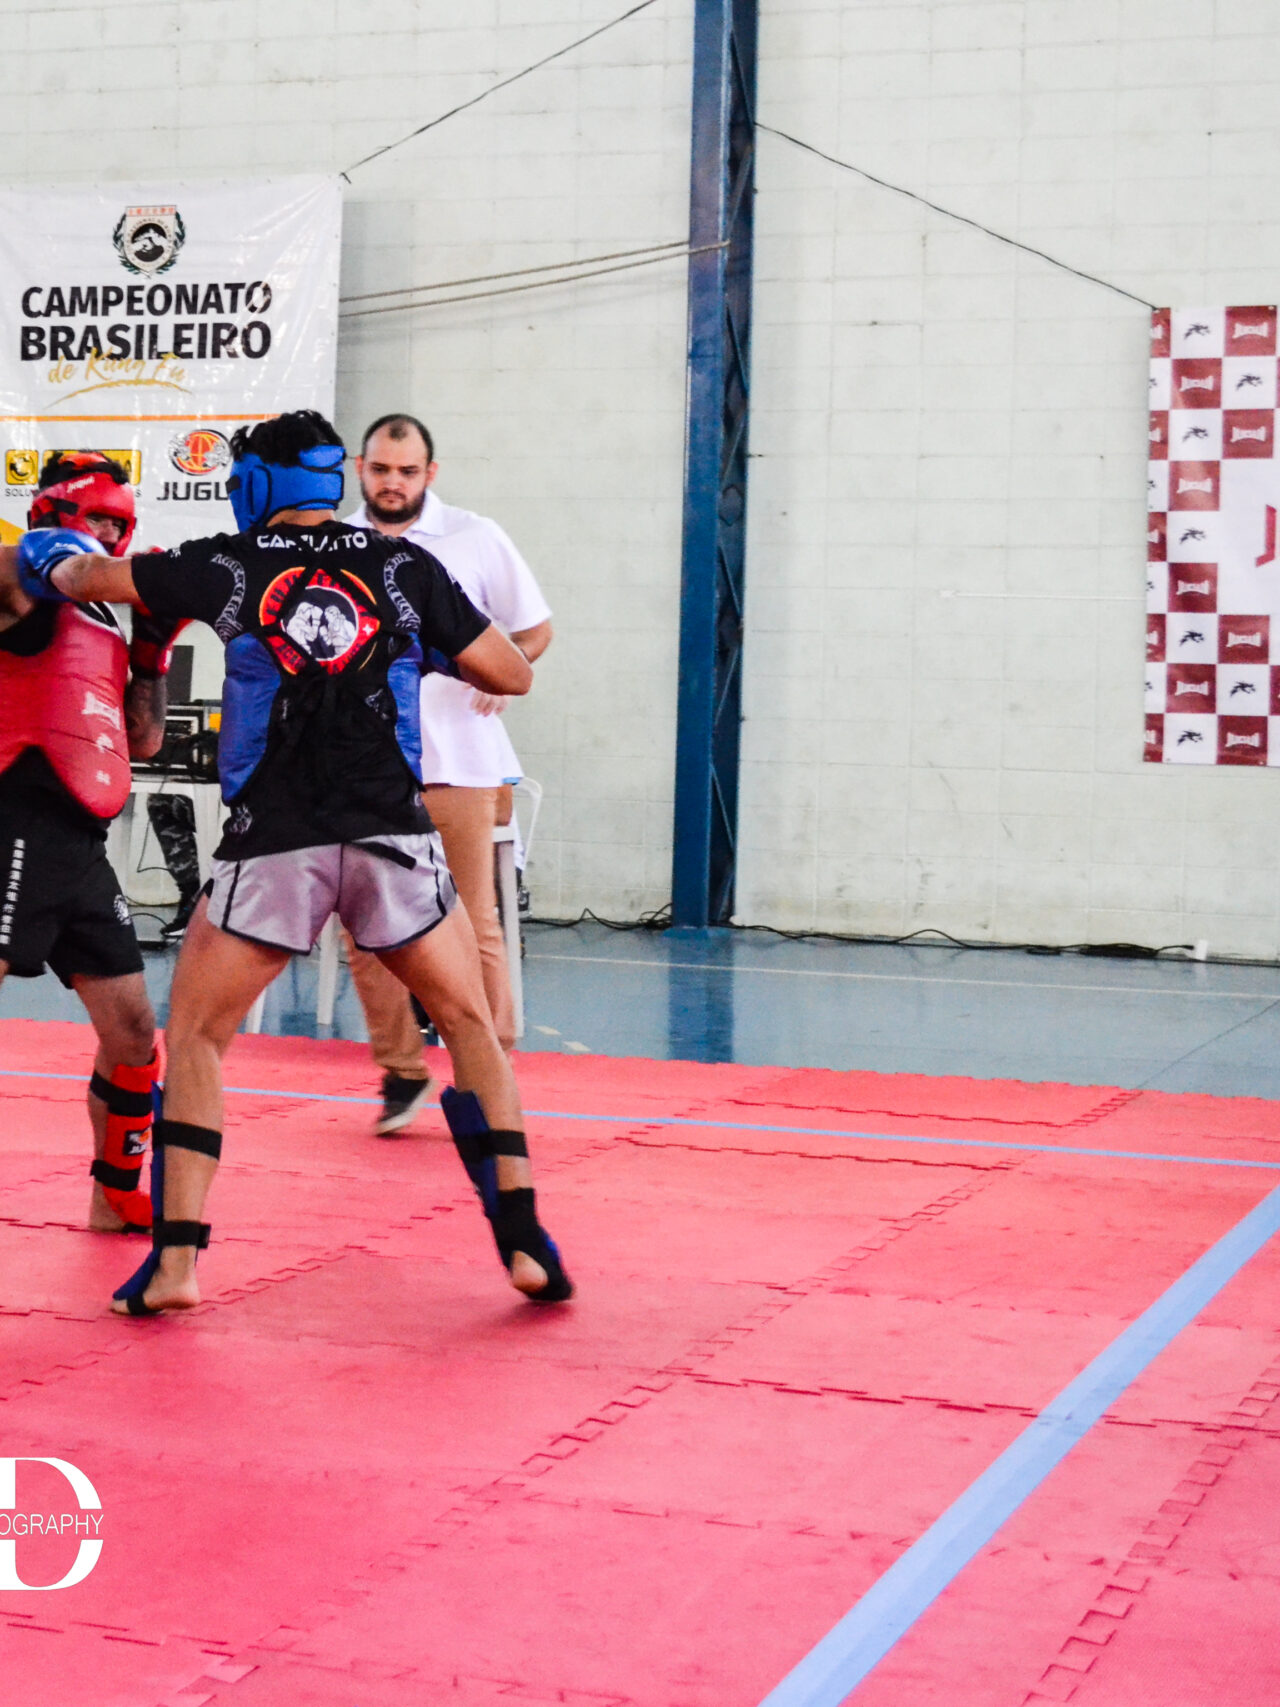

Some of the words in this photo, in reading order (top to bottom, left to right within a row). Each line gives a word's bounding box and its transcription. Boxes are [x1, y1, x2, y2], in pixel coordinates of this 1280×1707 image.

[21, 281, 272, 318] CAMPEONATO
[20, 321, 272, 361] BRASILEIRO
[48, 355, 75, 383] de
[85, 347, 146, 381] Kung
[153, 352, 186, 382] Fu
[156, 482, 229, 501] JUGU
